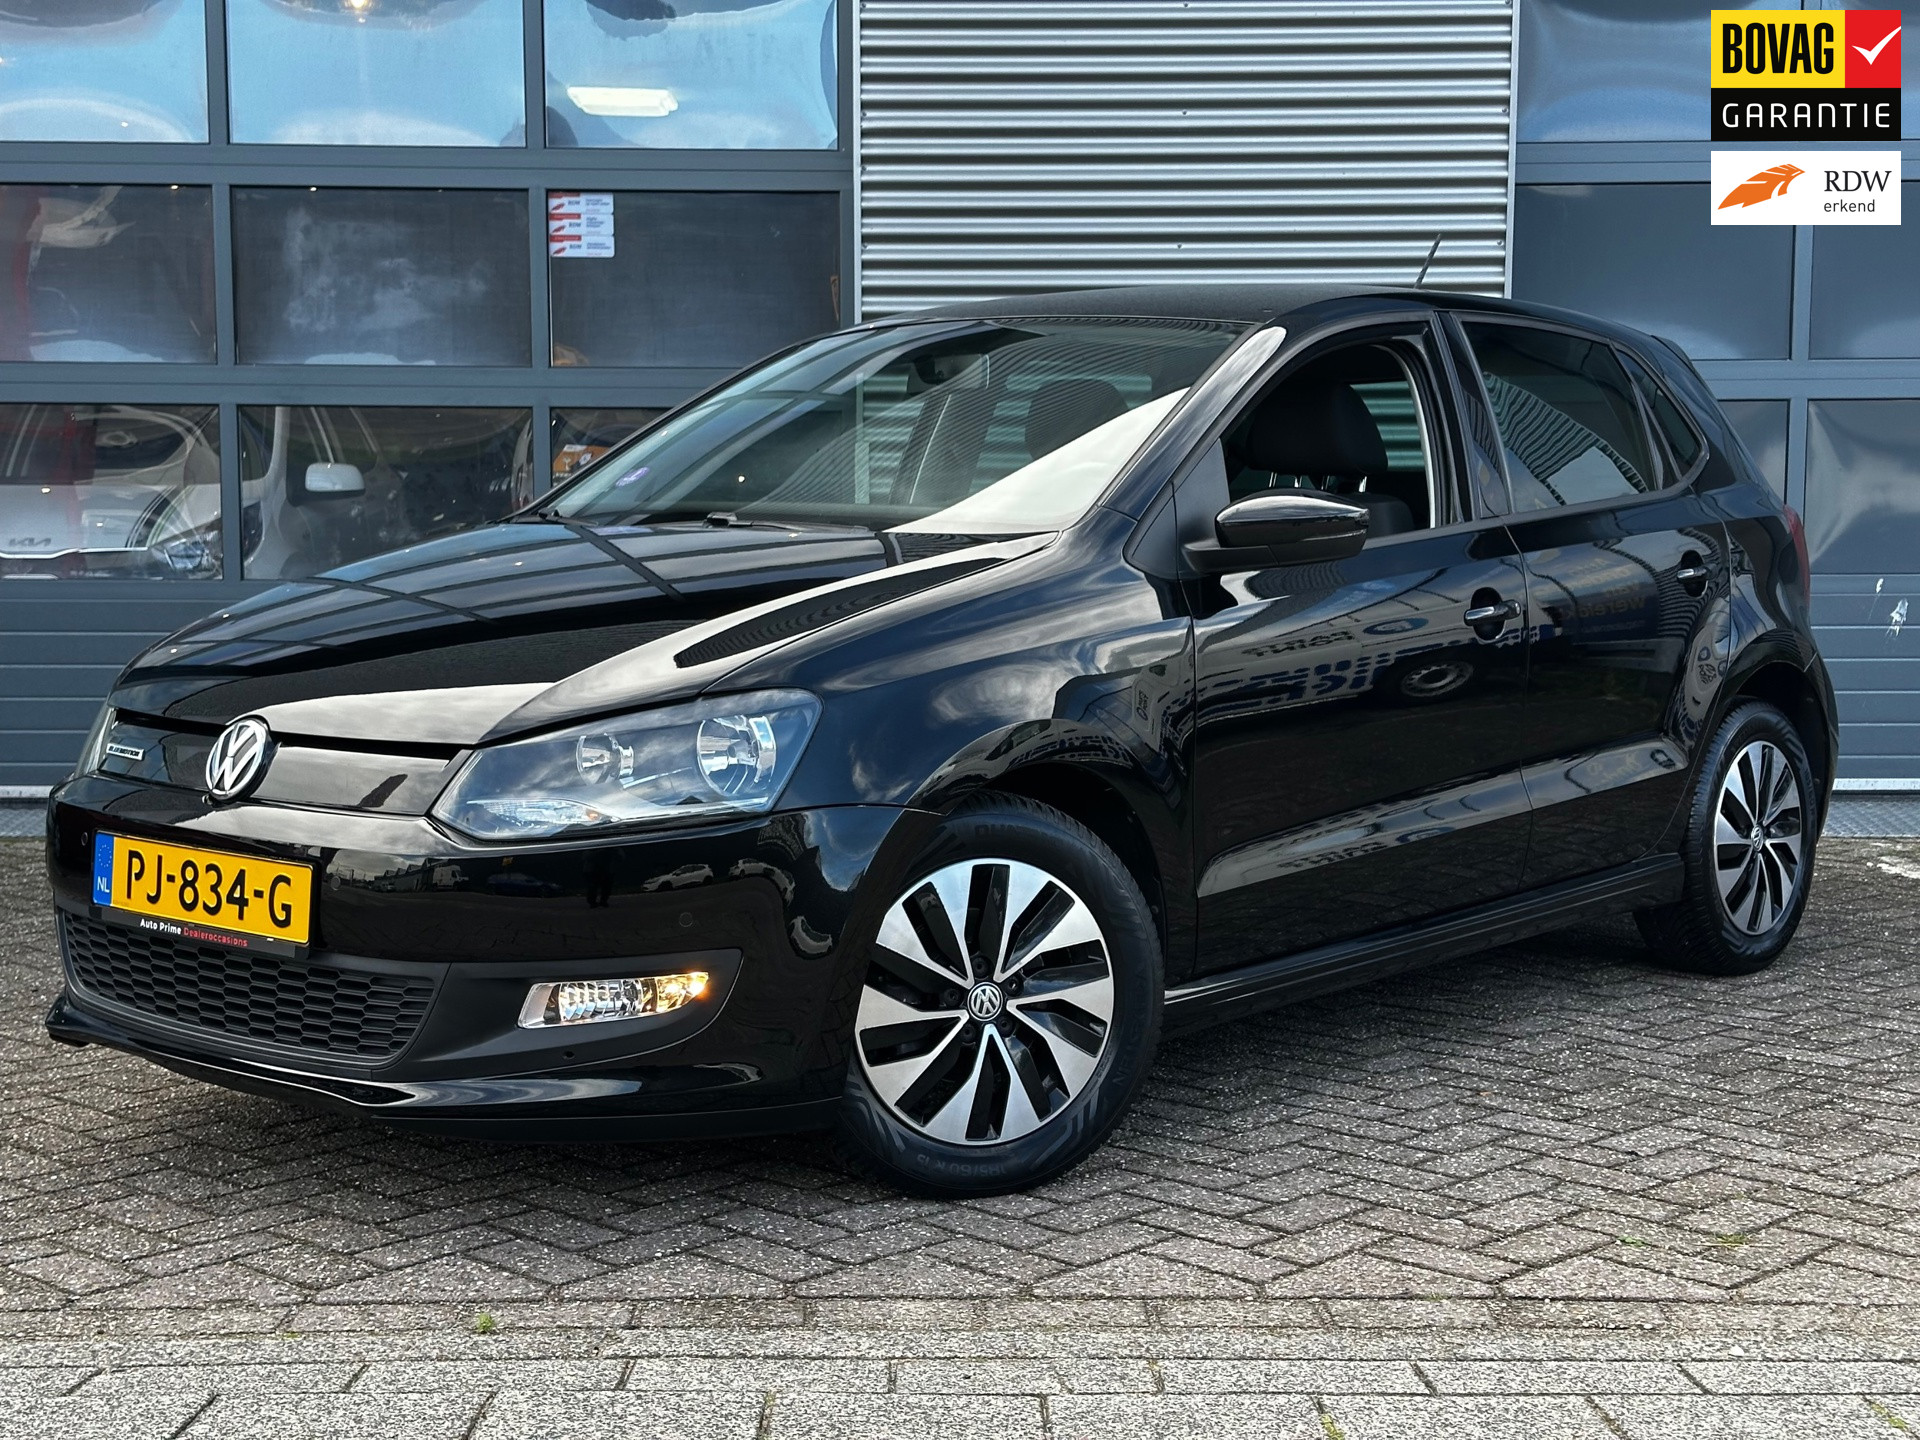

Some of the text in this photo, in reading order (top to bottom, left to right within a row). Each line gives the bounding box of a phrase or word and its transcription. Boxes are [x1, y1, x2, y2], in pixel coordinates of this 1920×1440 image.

[97, 876, 110, 893] NL
[126, 849, 292, 929] PJ-834-G
[140, 918, 248, 947] Auto Prime Dealeroccasions
